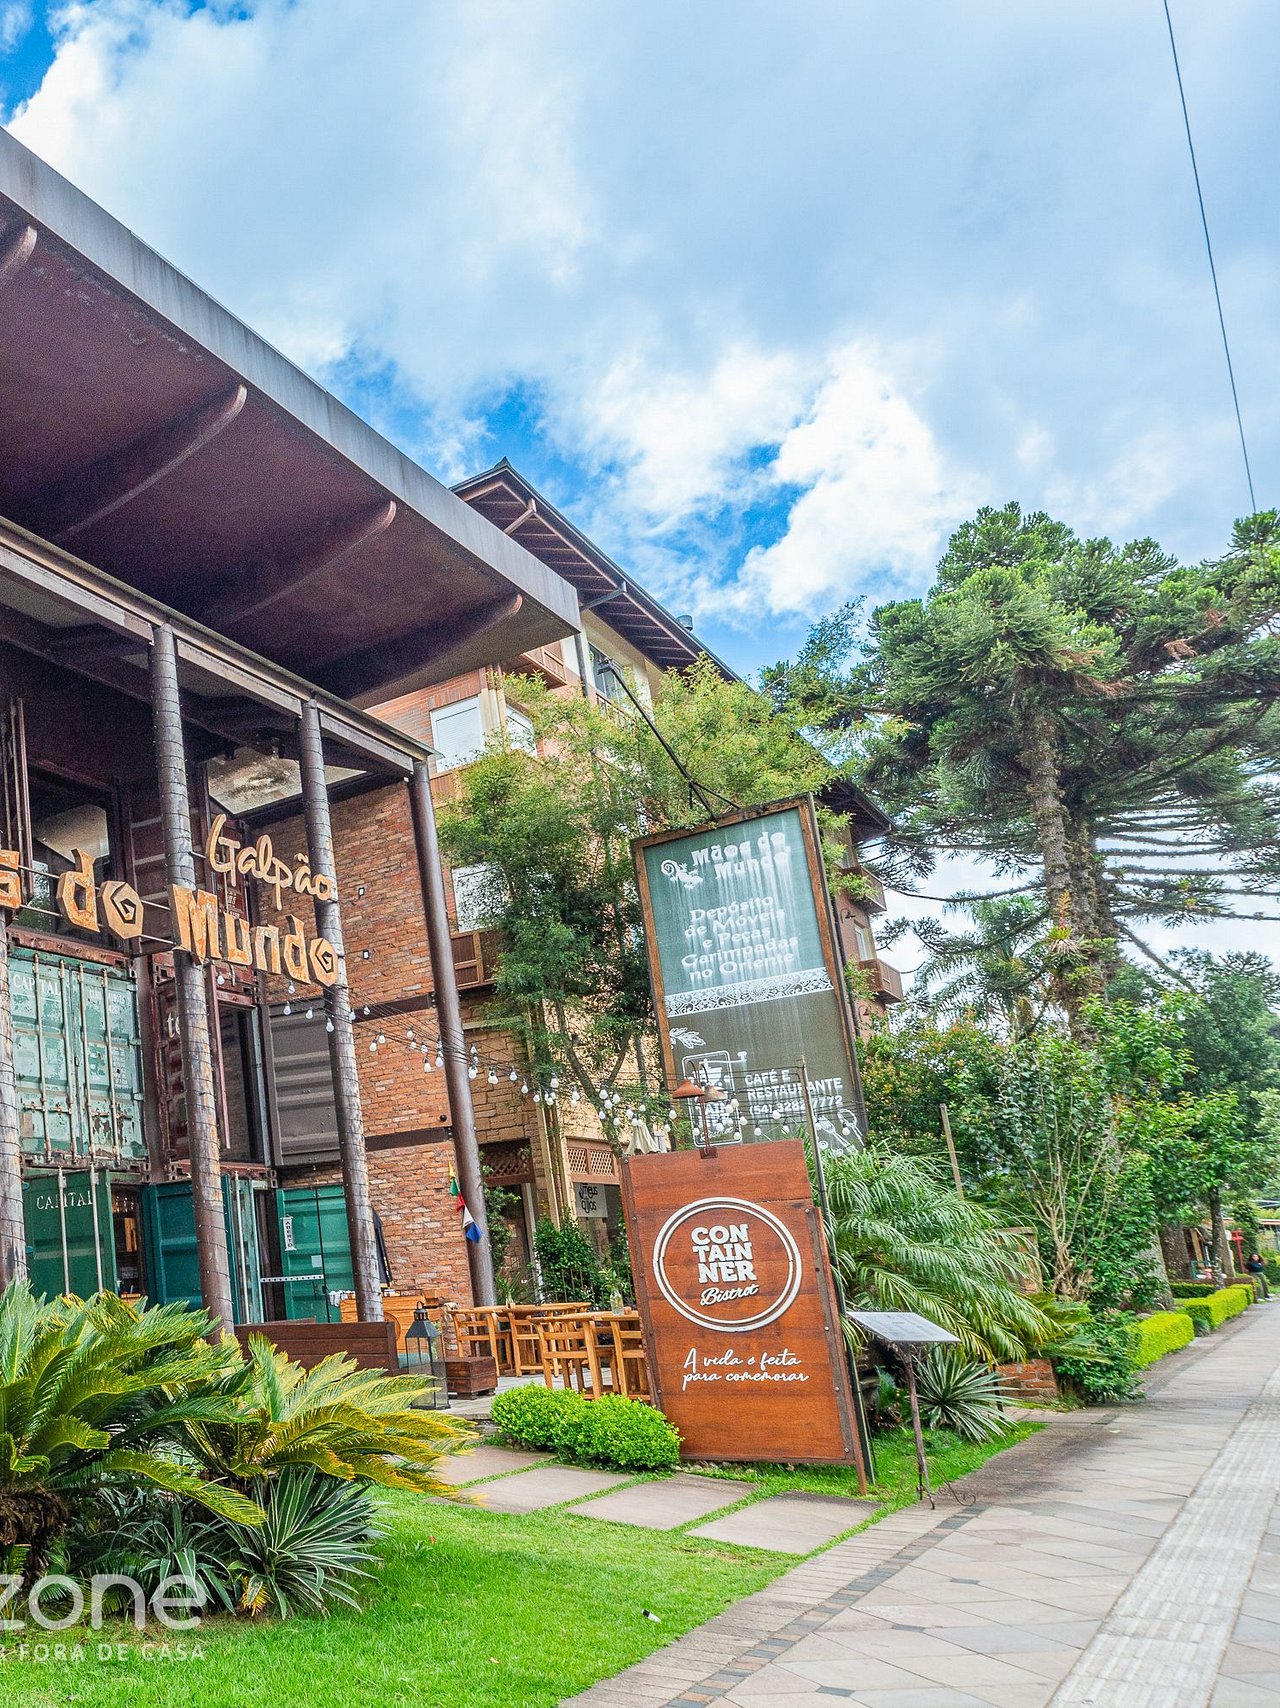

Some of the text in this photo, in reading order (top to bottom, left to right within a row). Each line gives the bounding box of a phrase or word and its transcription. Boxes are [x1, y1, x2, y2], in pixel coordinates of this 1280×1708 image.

[206, 813, 332, 911] Galpão
[57, 848, 144, 940] do
[171, 883, 339, 988] Mundo
[689, 896, 773, 922] Depósito
[684, 924, 707, 937] de
[702, 939, 713, 948] e
[13, 974, 61, 996] CAPTAL
[689, 969, 713, 981] no
[745, 1069, 791, 1085] CAFÉ E
[691, 1223, 749, 1246] CON
[692, 1242, 753, 1263] TAIN
[698, 1260, 757, 1284] NER
[700, 1283, 759, 1306] Bistrot
[683, 1347, 697, 1374] A
[703, 1349, 744, 1367] vida
[760, 1348, 802, 1371] feita
[682, 1371, 810, 1392] para comemorar
